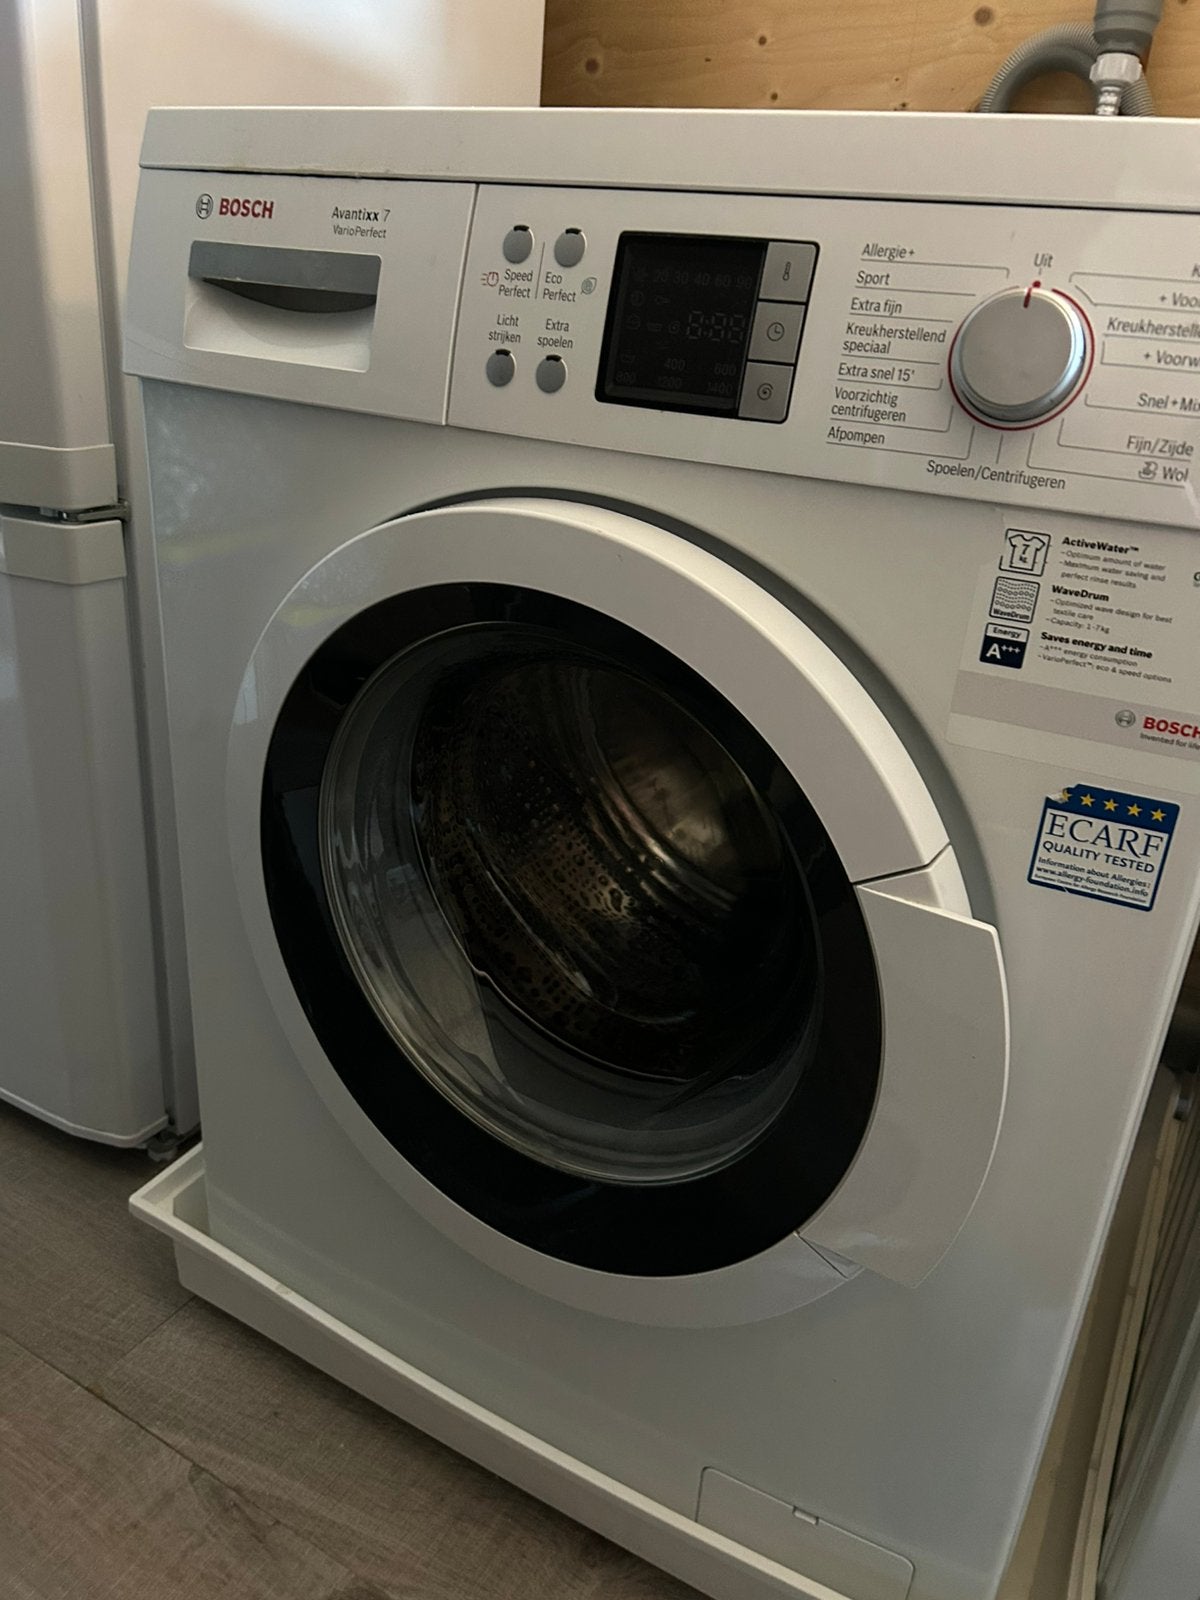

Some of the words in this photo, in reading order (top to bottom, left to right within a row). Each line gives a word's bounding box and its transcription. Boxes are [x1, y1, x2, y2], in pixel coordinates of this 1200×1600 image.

[219, 197, 274, 219] BOSCH
[331, 206, 379, 222] Avantixx
[382, 209, 391, 222] 7
[333, 224, 387, 239] VarioPerfect
[1033, 252, 1053, 268] Uit
[504, 268, 533, 283] Speed
[545, 271, 563, 284] Eco
[856, 270, 890, 286] Sport
[498, 284, 531, 299] Perfect
[542, 287, 576, 302] Perfect
[1171, 292, 1200, 307] Voo
[850, 297, 881, 312] Extra
[884, 298, 903, 315] fijn
[497, 314, 519, 327] Licht
[546, 318, 570, 333] Extra
[488, 330, 521, 344] strijken
[846, 322, 946, 343] Kreukherstellend
[537, 336, 573, 350] spoelen
[843, 340, 891, 356] speciaal
[838, 362, 868, 378] Extra
[870, 366, 894, 379] snel
[834, 386, 898, 407] Voorzichtig
[831, 403, 907, 422] centrifugeren
[827, 426, 885, 444] Afpompen
[1126, 435, 1194, 457] Fijn/Zijde
[926, 460, 1066, 489] Spoelen/Centrifugeren
[1162, 466, 1188, 482] Wol
[1021, 543, 1031, 555] 7
[1102, 556, 1133, 567] amount
[1101, 566, 1123, 575] water
[1150, 574, 1166, 582] and
[1052, 585, 1110, 602] WaveDrum
[993, 608, 1030, 620] WaveDrum
[1094, 605, 1114, 614] wave
[1115, 608, 1141, 619] design
[1142, 612, 1154, 621] for
[1155, 614, 1173, 624] best
[993, 626, 1022, 639] Energy
[1041, 632, 1070, 645] Saves
[1071, 638, 1107, 652] energy
[1107, 644, 1129, 655] and
[1129, 647, 1153, 659] time
[1063, 649, 1088, 659] energy
[1118, 668, 1142, 680] speed
[1139, 732, 1175, 745] Invented
[1175, 739, 1188, 748] for
[1045, 812, 1164, 858] ECARF
[1042, 840, 1101, 861] QUALITY
[1103, 853, 1155, 873] TESTED
[1038, 856, 1086, 873] Information
[1086, 867, 1110, 879] about
[1036, 865, 1149, 898] www.allergy-foundation.info
